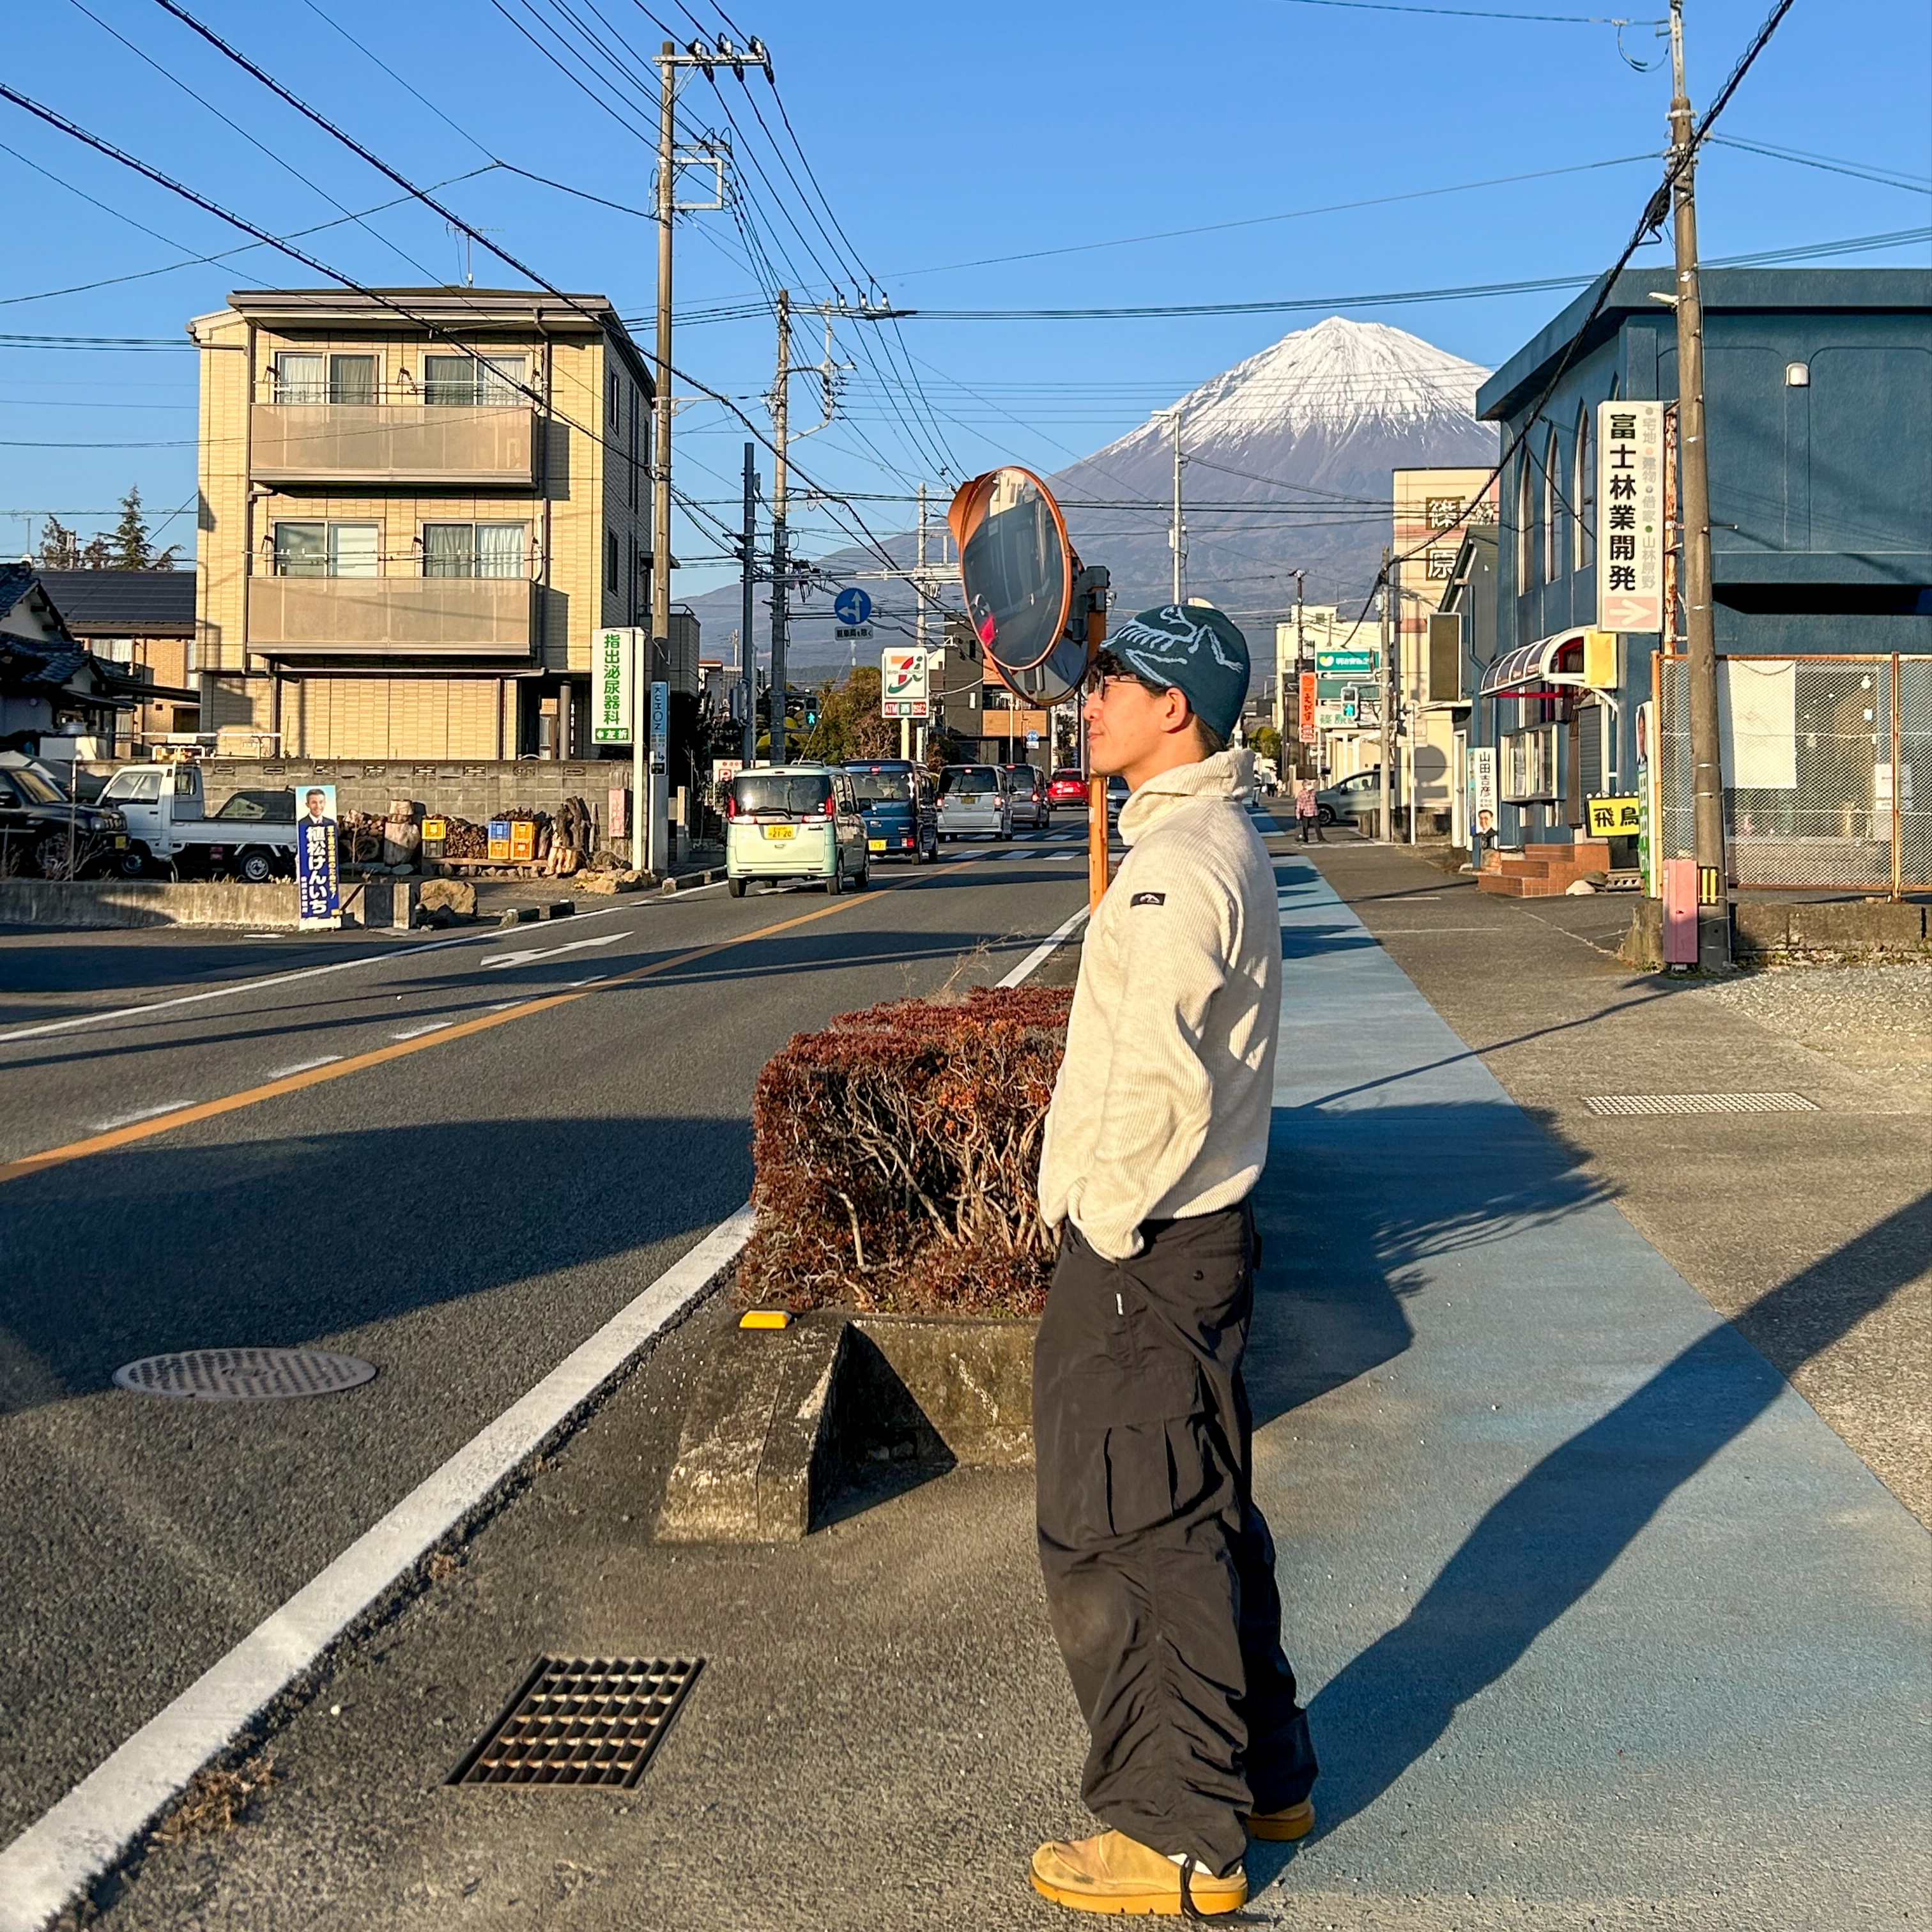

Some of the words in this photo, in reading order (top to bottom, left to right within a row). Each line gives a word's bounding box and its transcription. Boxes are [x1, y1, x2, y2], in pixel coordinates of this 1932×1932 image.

[1642, 417, 1657, 444] 宅地
[1642, 457, 1657, 484] 建物
[1609, 414, 1637, 591] 富士林業開発
[603, 634, 620, 725] 指出泌尿器科
[653, 687, 663, 730] KUMON
[885, 704, 898, 714] ATM
[606, 729, 628, 740] 左折
[1479, 751, 1491, 798] 山田吉彦
[1593, 807, 1639, 828] 飛鳥
[306, 825, 327, 915] 植松けんいち
